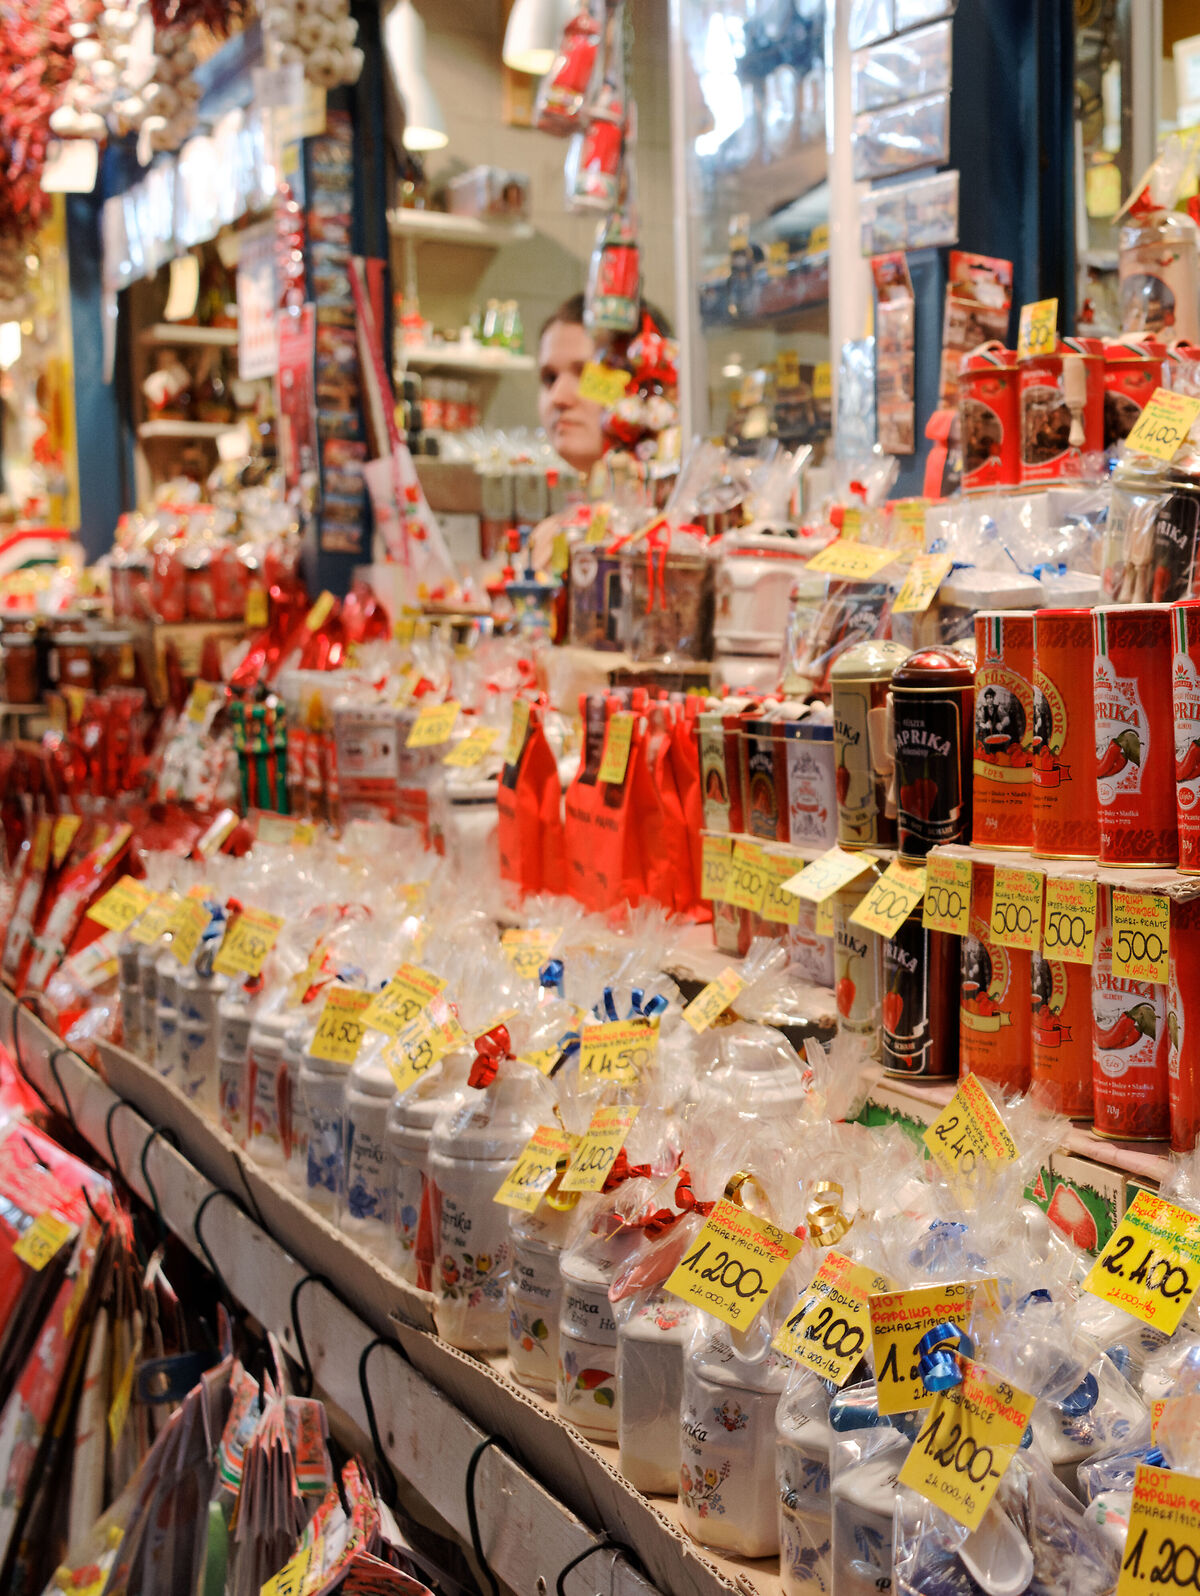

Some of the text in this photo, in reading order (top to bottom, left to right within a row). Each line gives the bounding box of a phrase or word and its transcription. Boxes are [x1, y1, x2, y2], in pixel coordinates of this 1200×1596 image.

[896, 729, 952, 757] APRIKA
[1093, 973, 1158, 1002] APRIKA
[717, 1200, 784, 1246] HOT 50g
[869, 1294, 906, 1311] HOT
[871, 1306, 932, 1324] PAPRIKA
[1138, 1468, 1171, 1488] HOT
